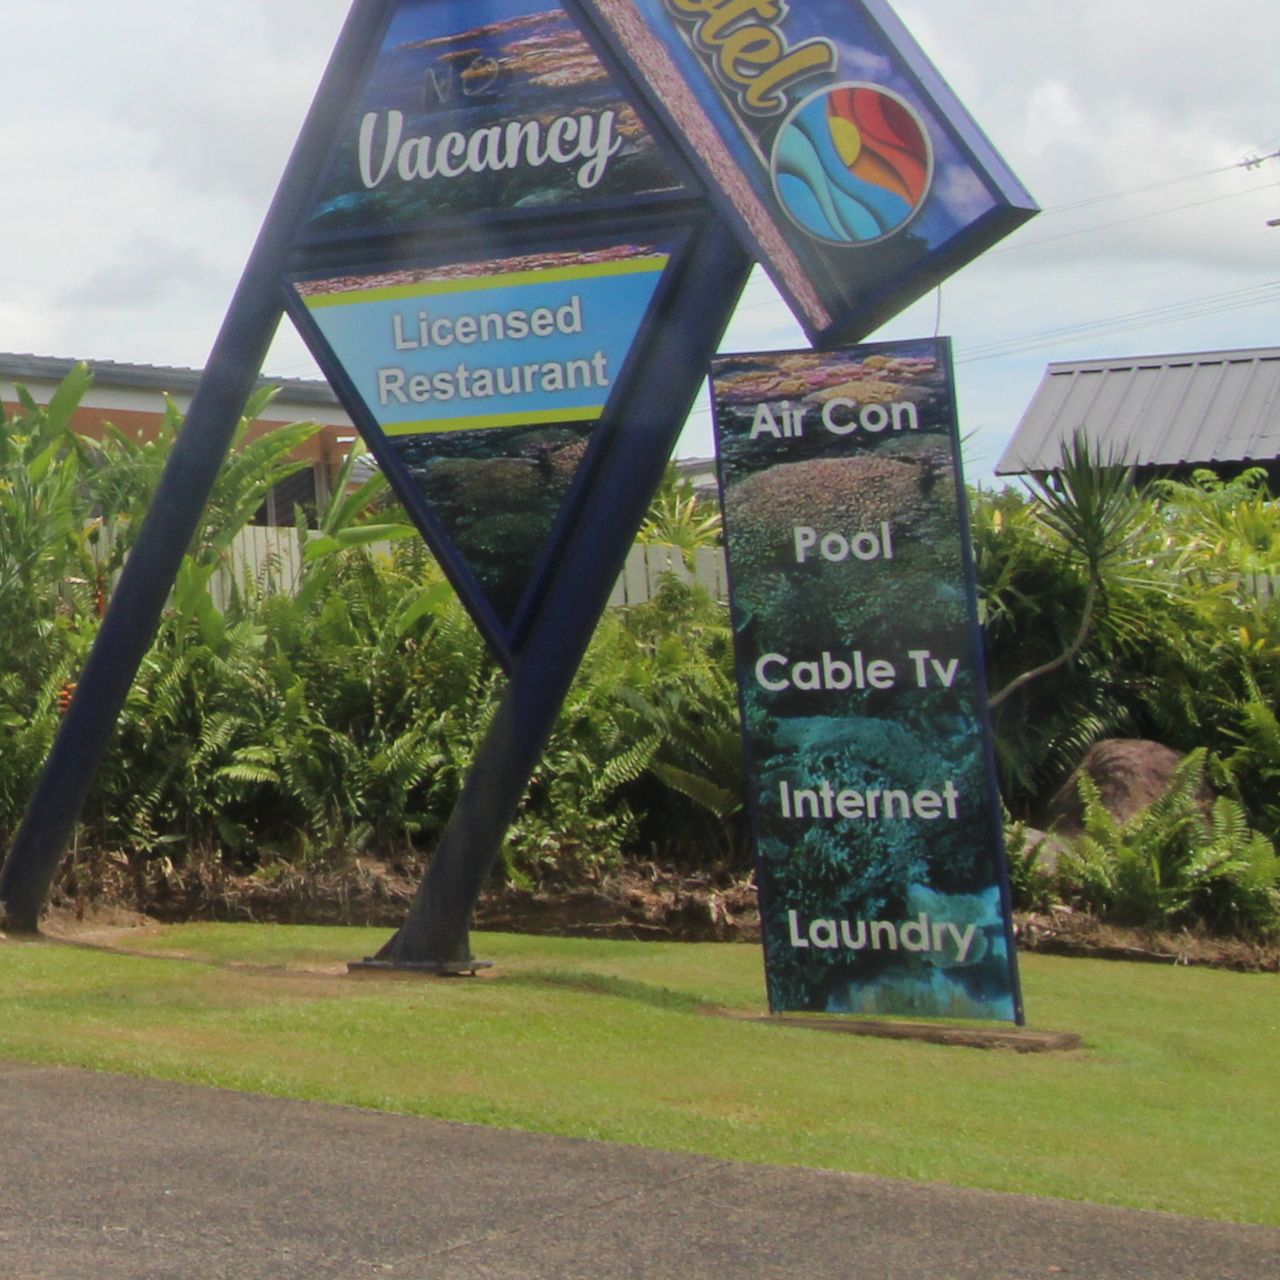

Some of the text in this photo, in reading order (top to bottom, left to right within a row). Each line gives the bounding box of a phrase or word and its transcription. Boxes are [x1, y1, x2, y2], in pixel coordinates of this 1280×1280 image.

[358, 109, 623, 189] Vacancy
[392, 295, 583, 351] Licensed
[377, 350, 610, 406] Restaurant
[748, 397, 919, 441] Air Con
[793, 521, 893, 564] Pool
[754, 649, 960, 693] Cable Tv
[780, 778, 960, 820] Internet
[788, 908, 977, 963] Laundry
